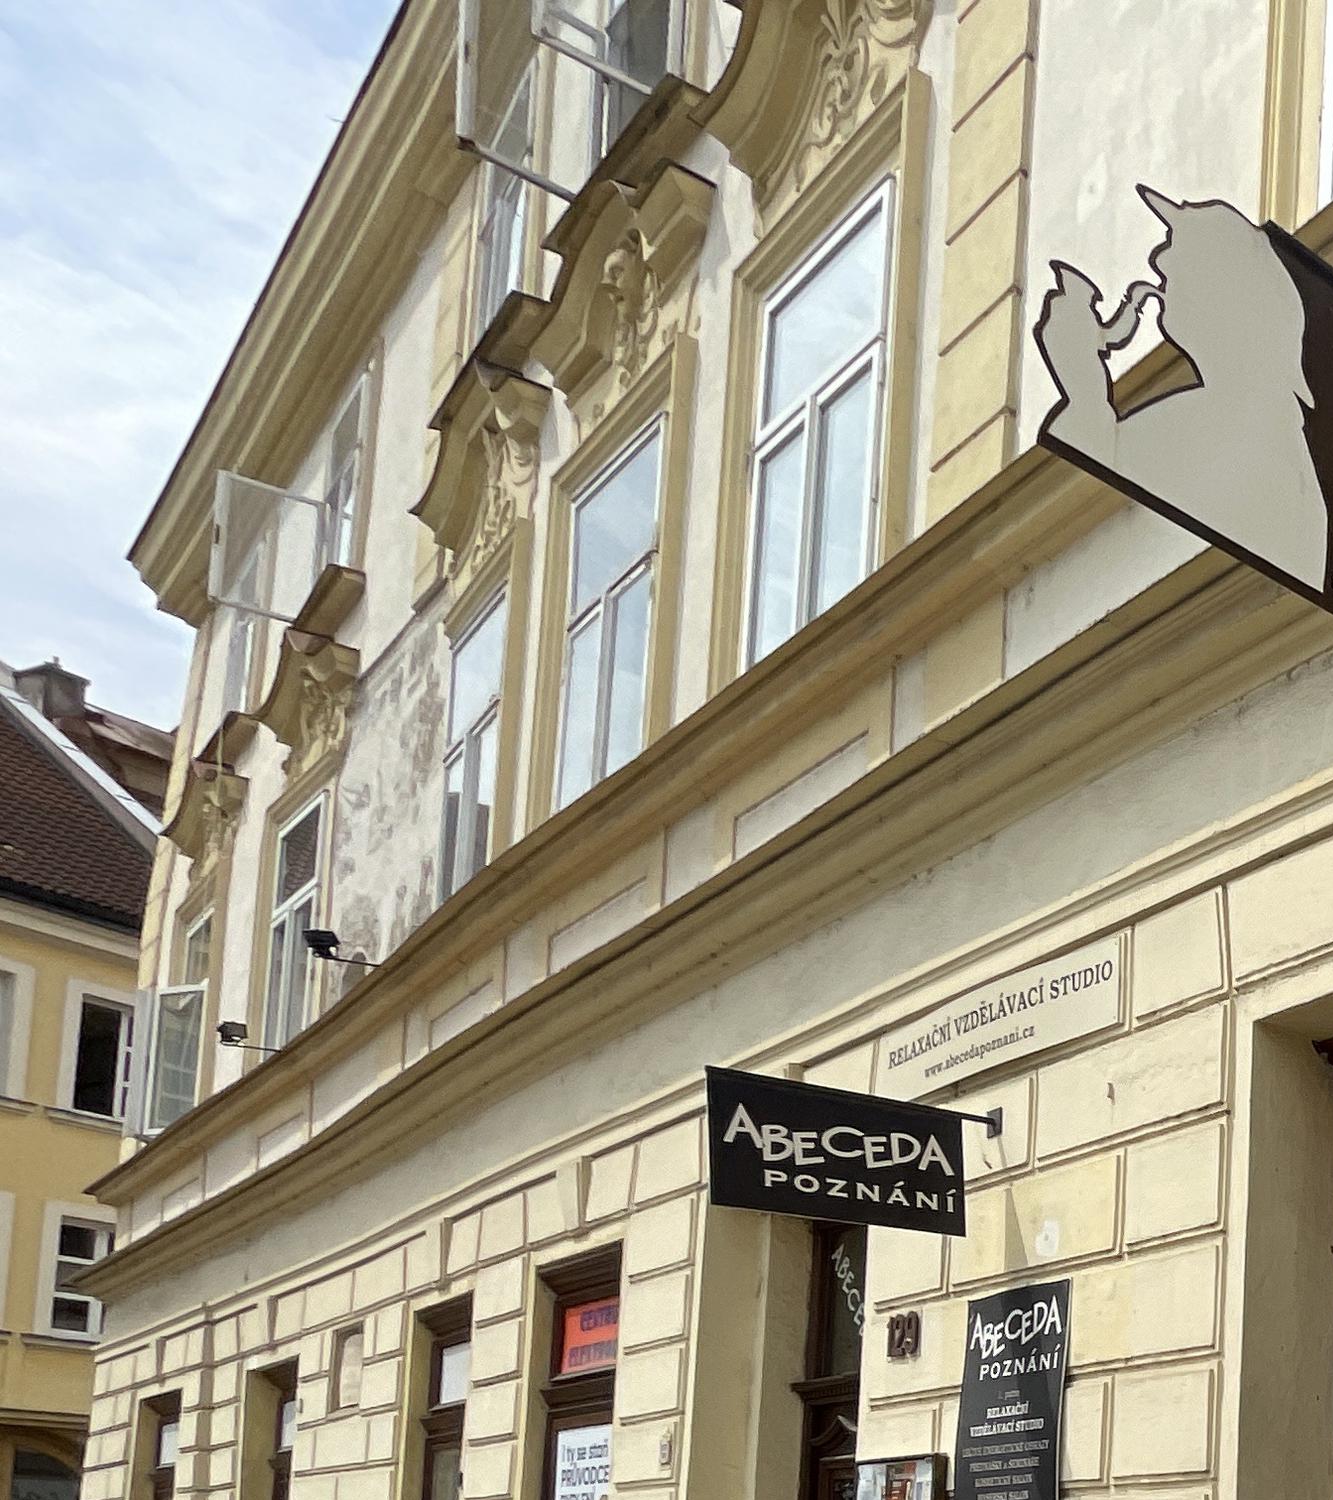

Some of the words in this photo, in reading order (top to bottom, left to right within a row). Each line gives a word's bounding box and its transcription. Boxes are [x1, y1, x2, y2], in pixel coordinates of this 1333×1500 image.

[887, 1014, 953, 1071] RELAXAČNÍ
[954, 976, 1046, 1037] VZDĚLÁVACÍ
[1048, 958, 1115, 1002] STUDIO
[722, 1102, 955, 1177] ABECEDA
[763, 1168, 957, 1214] POZNÁNÍ
[969, 1295, 1063, 1360] ABECEDA
[978, 1346, 1061, 1382] POZNÁNÍ
